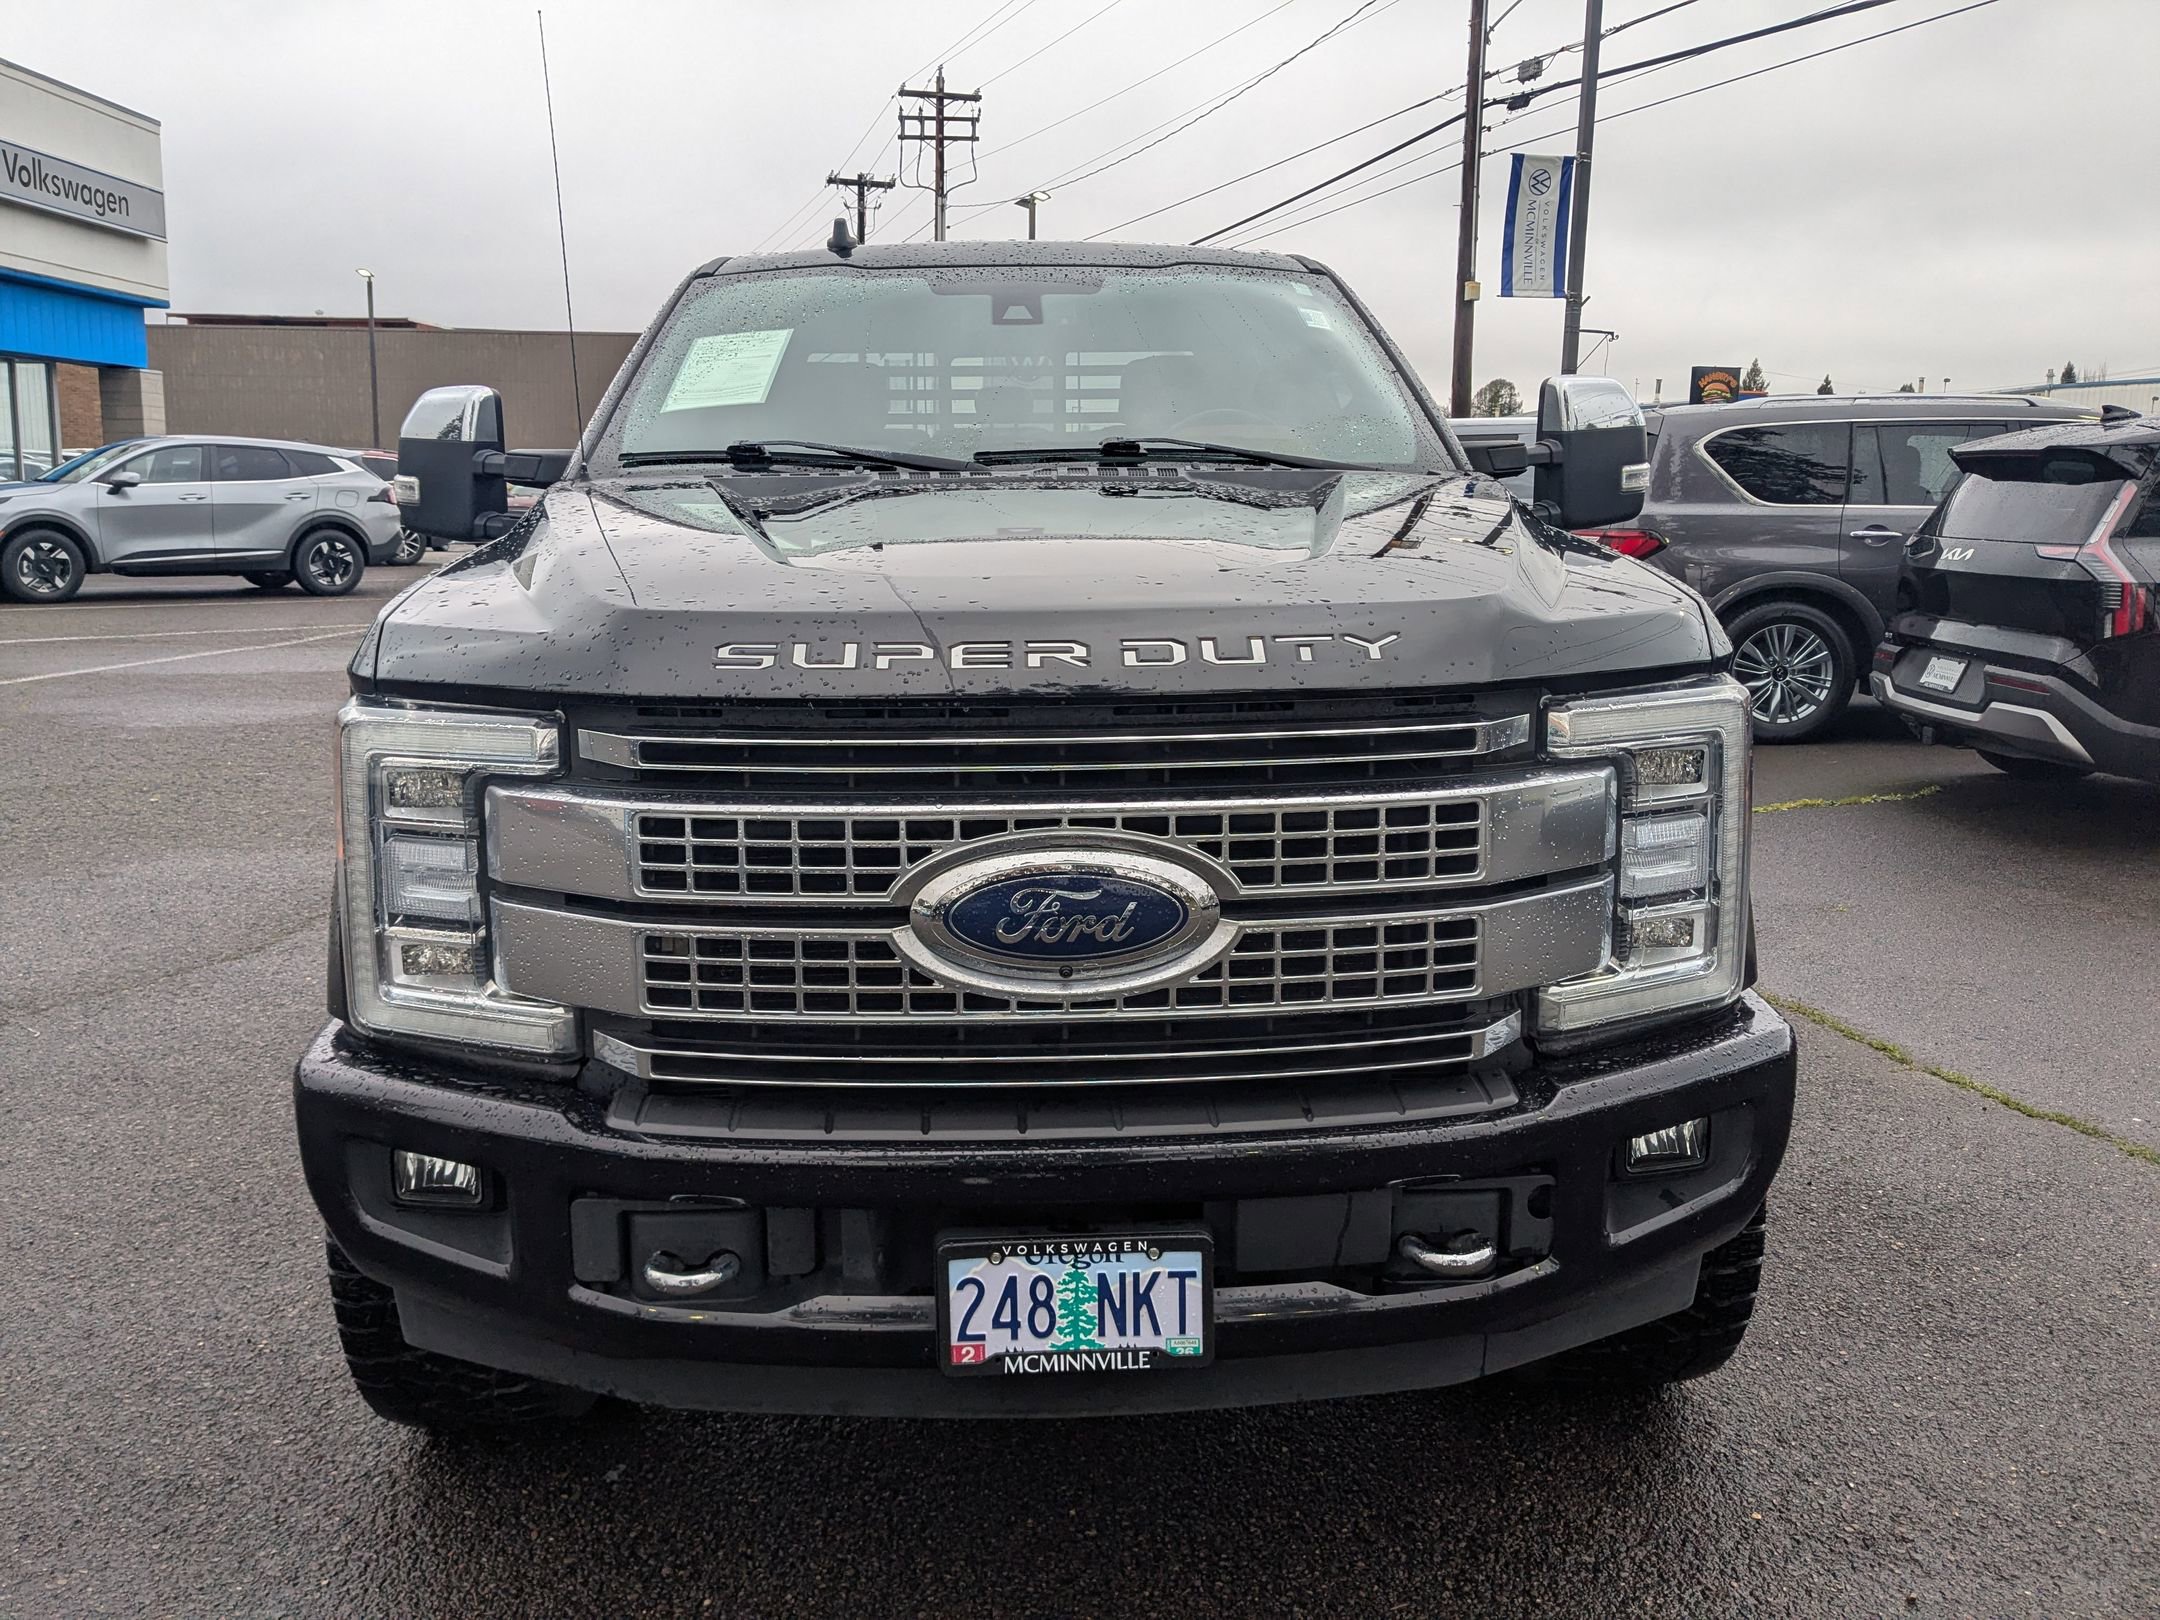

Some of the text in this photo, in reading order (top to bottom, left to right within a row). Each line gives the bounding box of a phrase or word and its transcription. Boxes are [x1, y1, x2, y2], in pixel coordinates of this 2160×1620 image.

[1, 148, 130, 217] Volkswagen
[1523, 199, 1537, 285] MCMINNVILLE
[1539, 200, 1551, 281] VOLKSWAGEN
[714, 631, 1401, 671] SUPER DUTY
[995, 887, 1138, 944] Ford
[1002, 1240, 1148, 1256] VOLKSWAGEN
[955, 1270, 1198, 1343] 248 NKT
[1004, 1351, 1151, 1374] MCMINNVILLE
